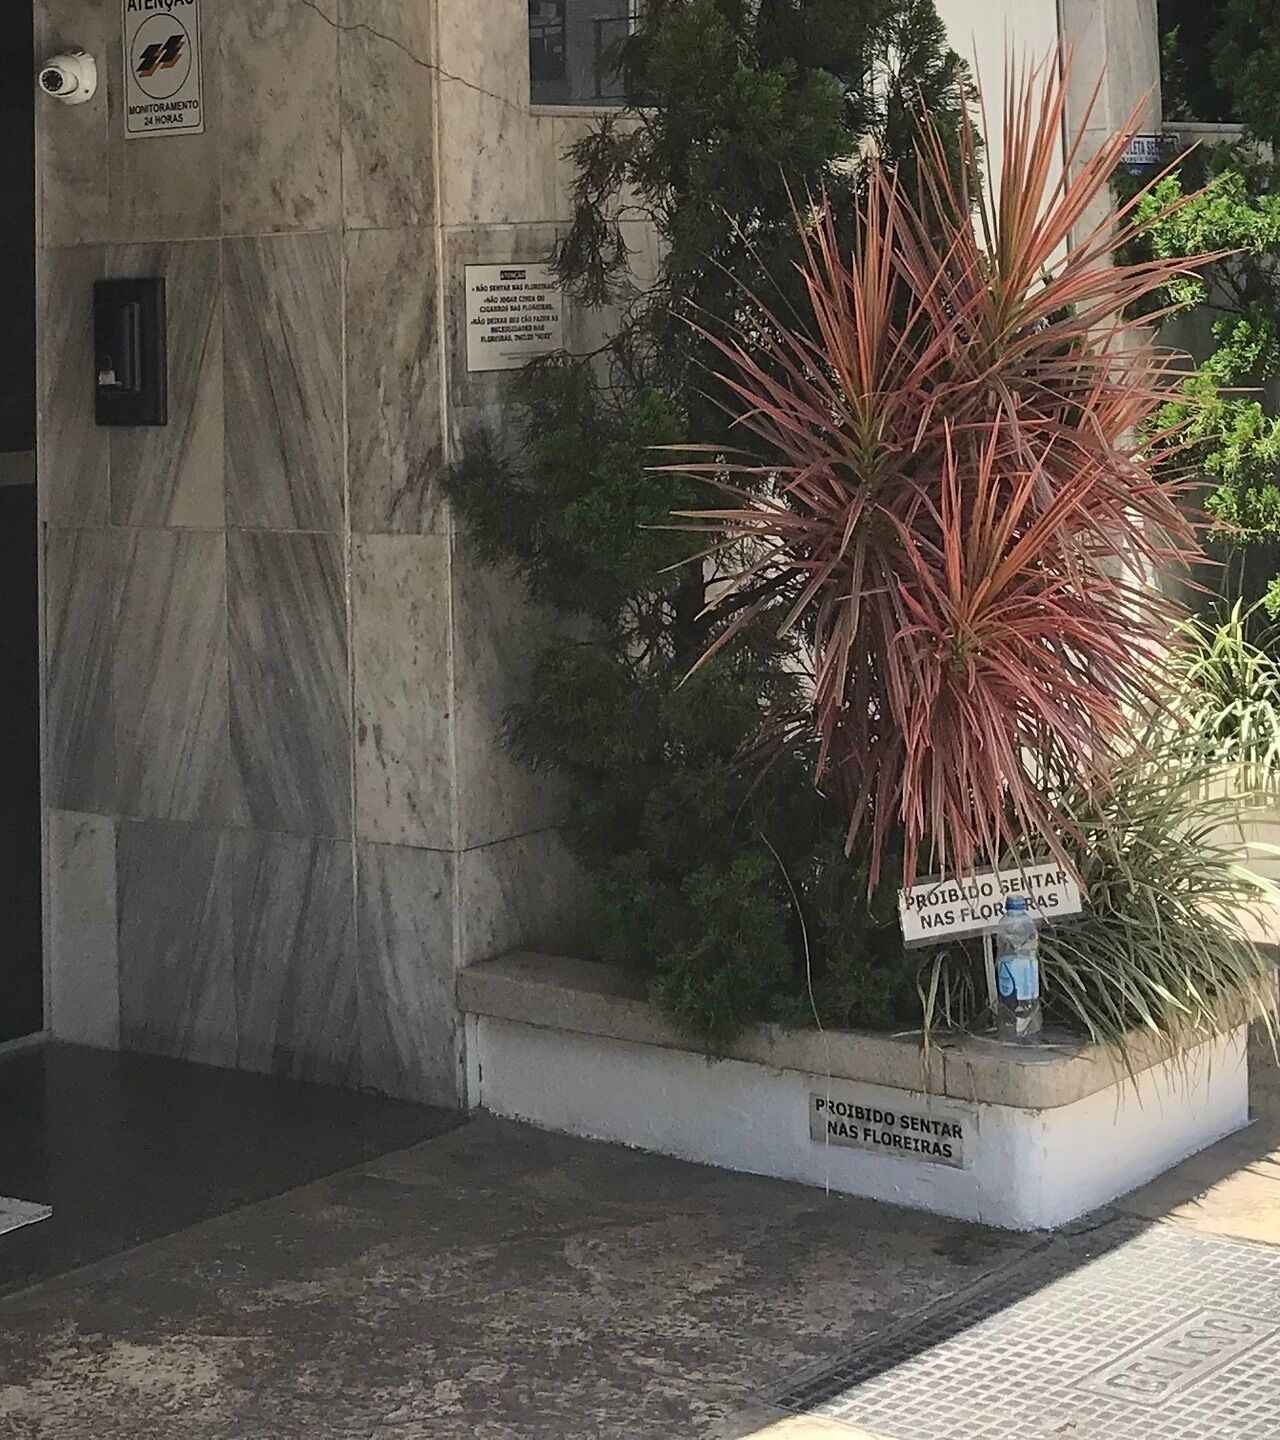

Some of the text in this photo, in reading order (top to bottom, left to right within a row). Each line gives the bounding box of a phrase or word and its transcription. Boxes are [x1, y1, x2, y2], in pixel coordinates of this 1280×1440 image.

[129, 99, 199, 115] MONITORAMENTO
[144, 113, 183, 126] 24 HORAS
[905, 871, 1069, 910] PROIBIDO SENTAR
[920, 893, 1059, 930] NAS FLORRAS
[815, 1098, 963, 1140] PROIBIDO SENTAR
[828, 1120, 953, 1158] NAS FLOREIRAS
[1105, 1318, 1255, 1393] CELESC
